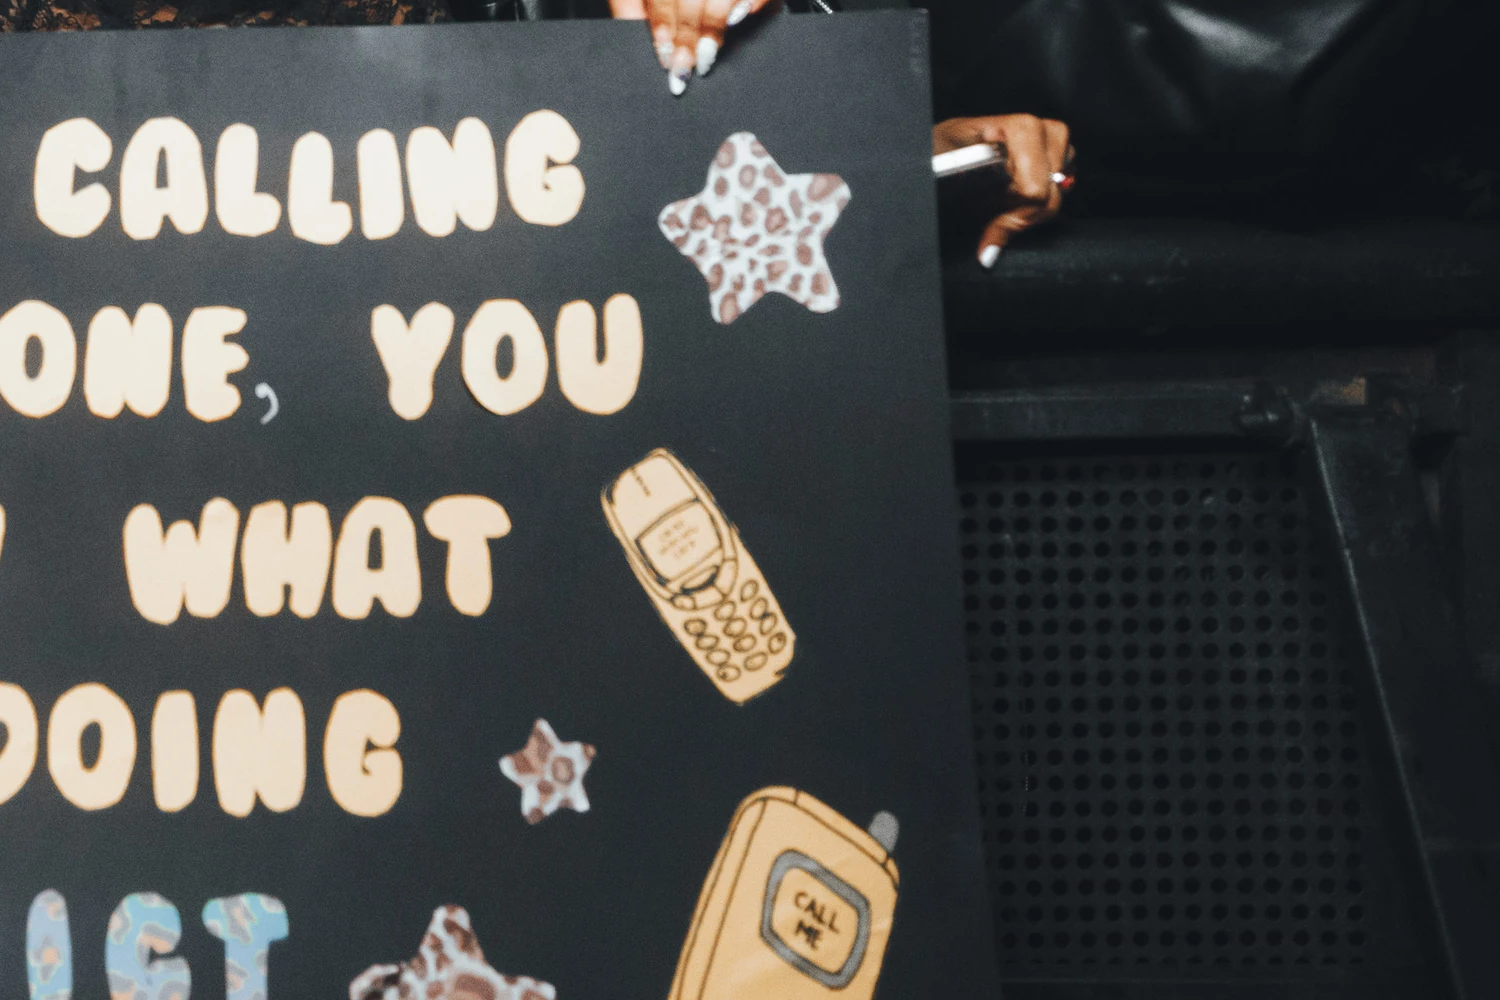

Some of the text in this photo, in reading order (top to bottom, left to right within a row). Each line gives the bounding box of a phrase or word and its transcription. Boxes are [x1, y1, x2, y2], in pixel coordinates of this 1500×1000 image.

[32, 108, 587, 246] CALLING
[370, 292, 644, 421] YOU
[122, 494, 512, 626] WHAT
[794, 891, 840, 934] CALL
[794, 919, 821, 951] ME
